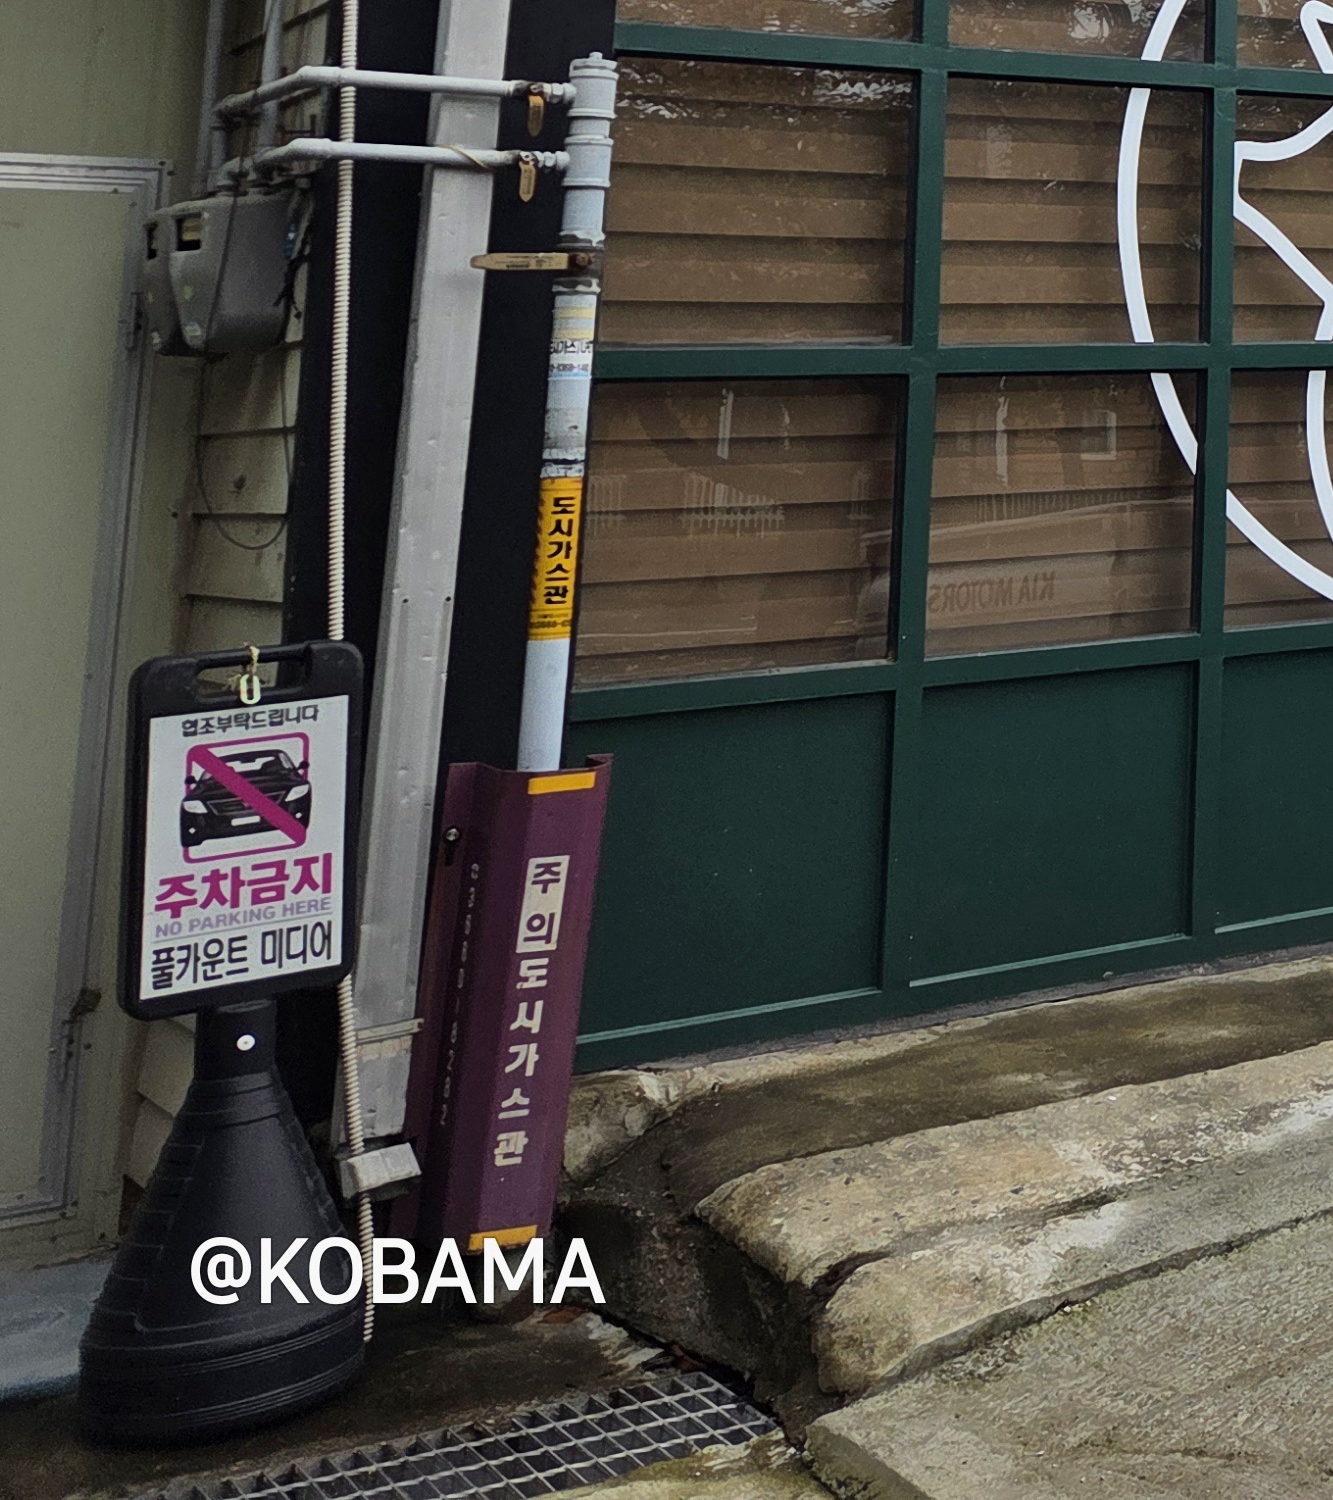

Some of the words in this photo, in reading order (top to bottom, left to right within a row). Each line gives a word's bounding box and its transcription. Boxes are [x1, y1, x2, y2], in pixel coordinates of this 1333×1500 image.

[543, 495, 576, 605] 도시가스관
[181, 704, 319, 738] 협조부탁드립니다
[154, 852, 333, 919] 주차금지
[155, 920, 182, 938] NO
[188, 905, 276, 933] PARKING
[282, 897, 332, 918] HERE
[152, 935, 249, 990] 풀카운트
[261, 920, 332, 969] 미디어
